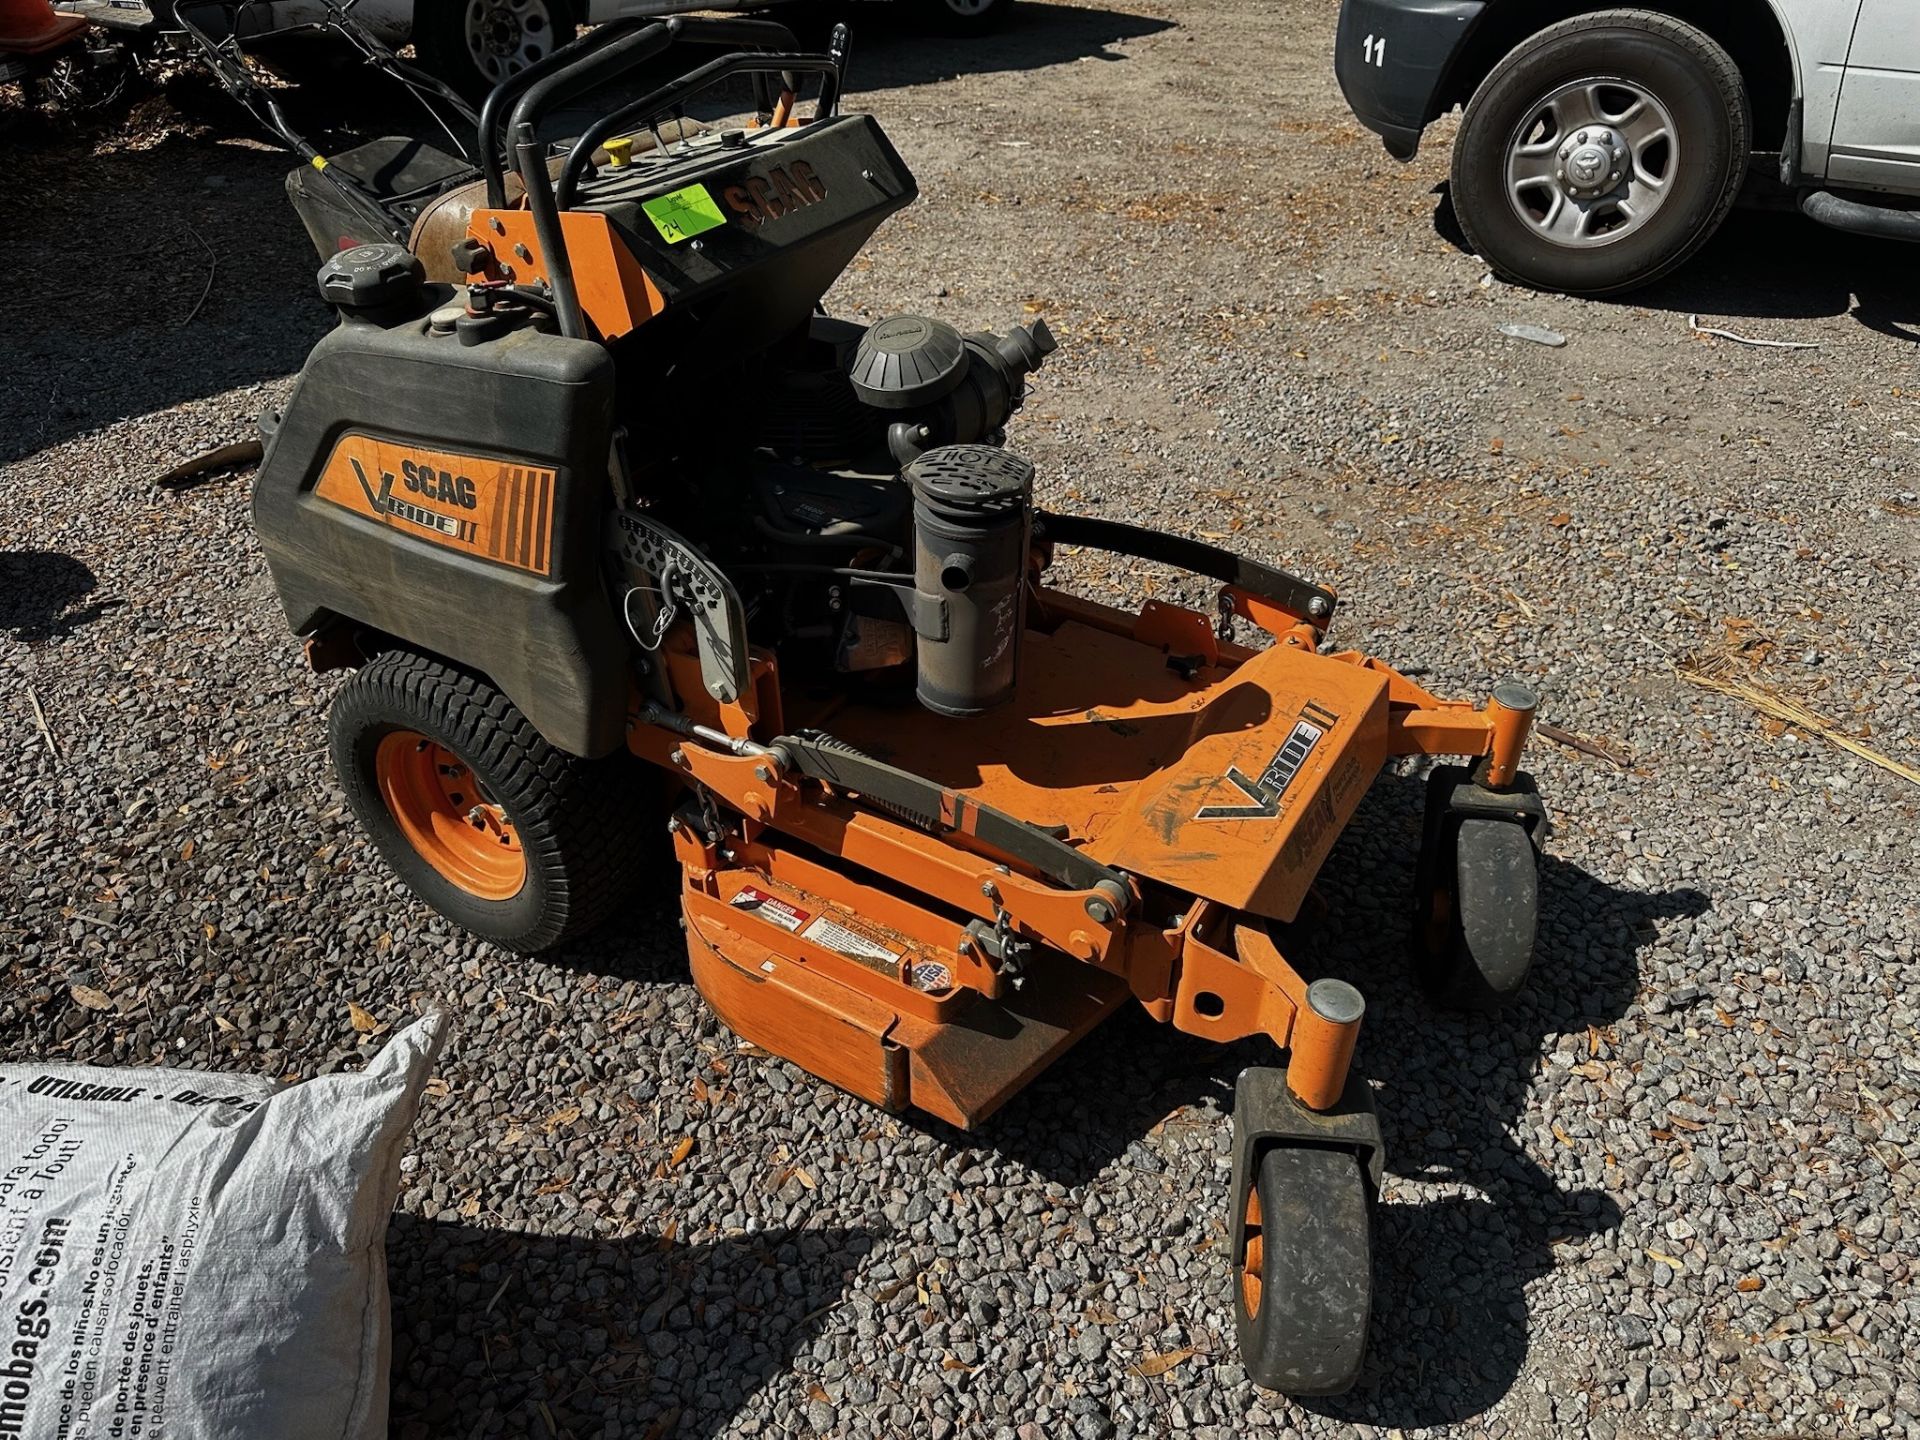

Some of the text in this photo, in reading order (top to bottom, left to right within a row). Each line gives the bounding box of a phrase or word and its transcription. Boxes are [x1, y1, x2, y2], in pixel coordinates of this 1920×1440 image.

[1362, 34, 1387, 68] 11
[723, 159, 828, 227] SCAG
[663, 217, 686, 239] 24
[943, 451, 997, 465] HOT
[402, 459, 477, 510] SCAG
[766, 897, 797, 916] DANGER
[849, 922, 889, 947] WARNING
[923, 964, 945, 985] USA
[27, 1075, 147, 1102] UTILSABLE
[22, 1118, 75, 1161] todo!
[30, 1140, 84, 1180] Tout!
[18, 1188, 45, 1200] à
[97, 1223, 110, 1244] un
[92, 1246, 104, 1267] es
[78, 1360, 98, 1423] pueden
[89, 1300, 110, 1356] causar
[108, 1259, 154, 1438] de portée des jouets.
[151, 1359, 171, 1424] peuvent
[161, 1279, 184, 1354] entrainer
[64, 1349, 82, 1375] los
[133, 1332, 156, 1411] présence
[60, 1379, 75, 1400] de
[130, 1414, 143, 1435] en
